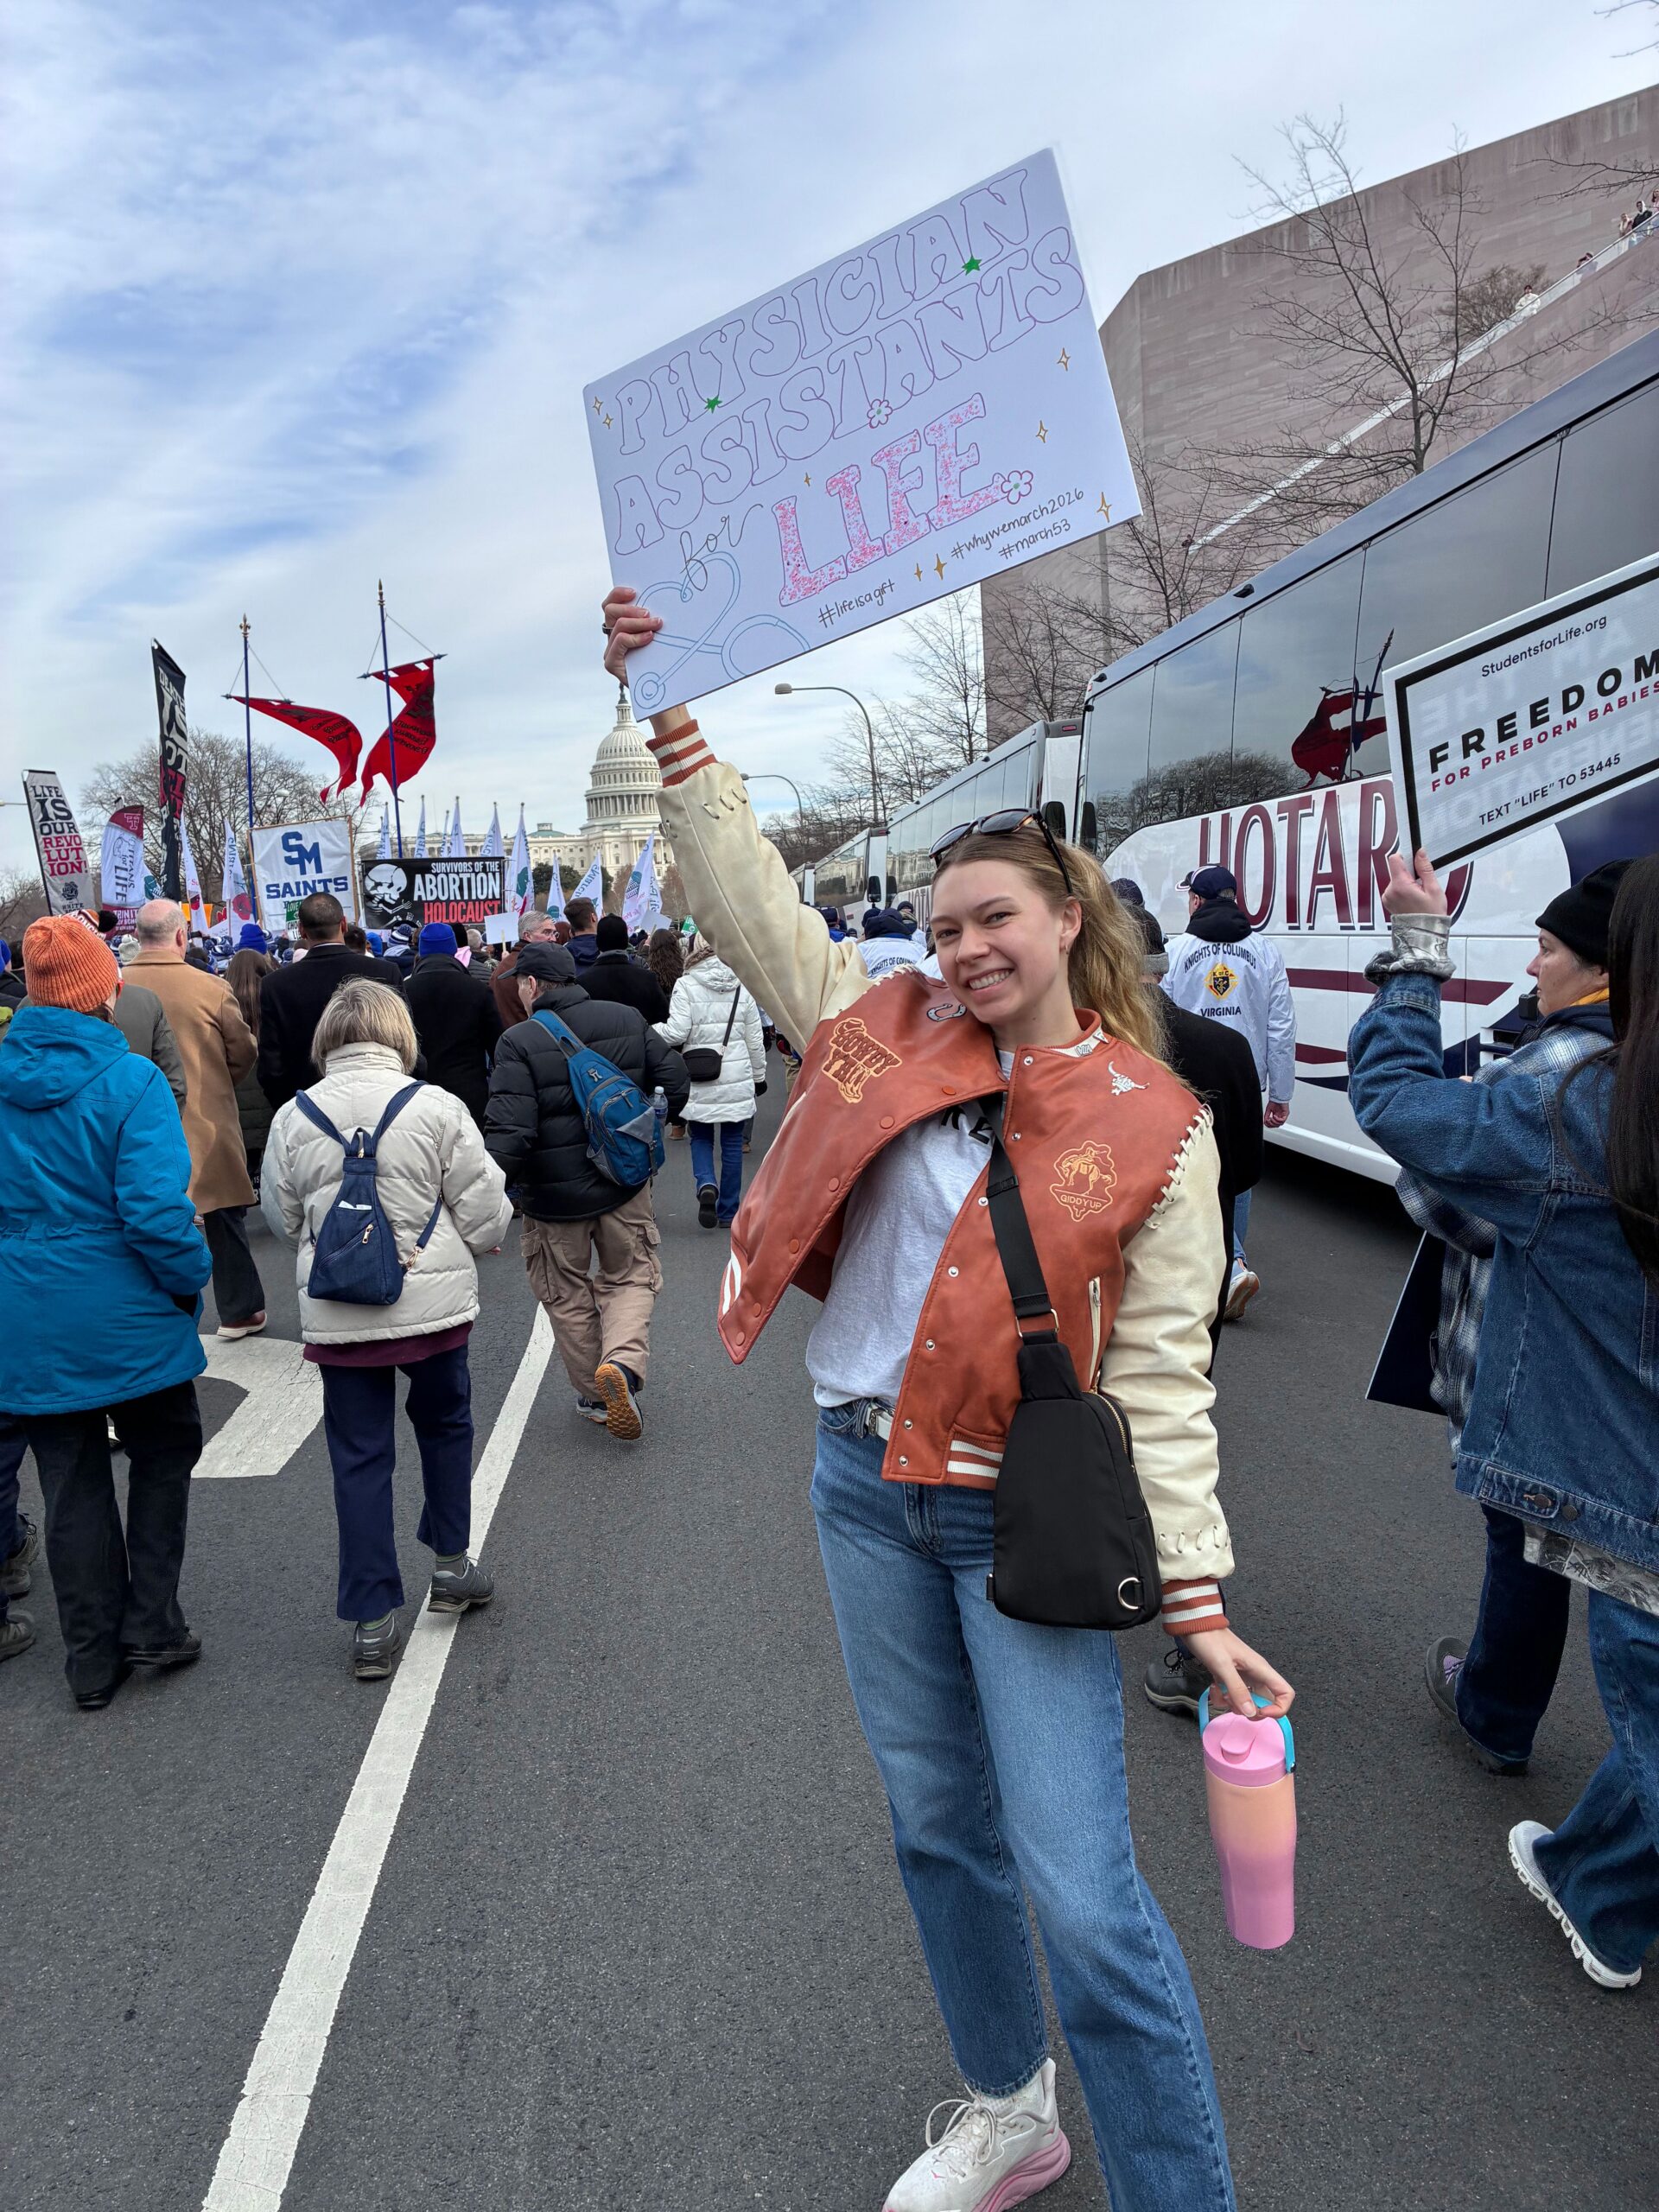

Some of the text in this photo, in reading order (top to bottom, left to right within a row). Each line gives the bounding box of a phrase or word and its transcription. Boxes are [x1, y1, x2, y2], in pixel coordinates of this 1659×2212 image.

[619, 168, 1030, 455] PHYSICIAN
[614, 226, 1084, 556] ASSISTANTS
[772, 393, 1005, 607] LIFE
[951, 488, 1084, 560] #whywemarch2026
[998, 518, 1071, 559] #march53
[679, 503, 764, 592] for
[818, 578, 895, 628] #lifeisagift
[1481, 616, 1607, 677] StudentsforLife.org
[158, 666, 186, 711] DEATH
[1429, 648, 1659, 774] FREEDOM
[1432, 681, 1659, 792] FOR PREBORN BABIES
[30, 785, 63, 798] LIFE
[1478, 801, 1511, 826] TEXT
[1558, 773, 1577, 791] TO
[1580, 753, 1621, 780] 53445
[35, 798, 73, 823] IS
[39, 822, 79, 836] OUR
[42, 835, 83, 849] REVO
[44, 848, 85, 863] LUT
[282, 831, 323, 875] SM
[1199, 779, 1474, 932] HOTAR
[46, 861, 88, 877] ION!
[113, 865, 129, 903] LIFE
[413, 872, 500, 901] ABORTION
[431, 861, 500, 874] SURVIVORS OF THE
[266, 876, 348, 899] SAINTS
[112, 909, 139, 919] TRINIT
[423, 900, 501, 925] HOLOCAUST
[888, 957, 895, 965] OF
[1184, 943, 1256, 973] KNIGHTS OF COLUMBUS
[1200, 1006, 1242, 1017] VIRGINIA
[830, 1030, 901, 1075] HOWDY
